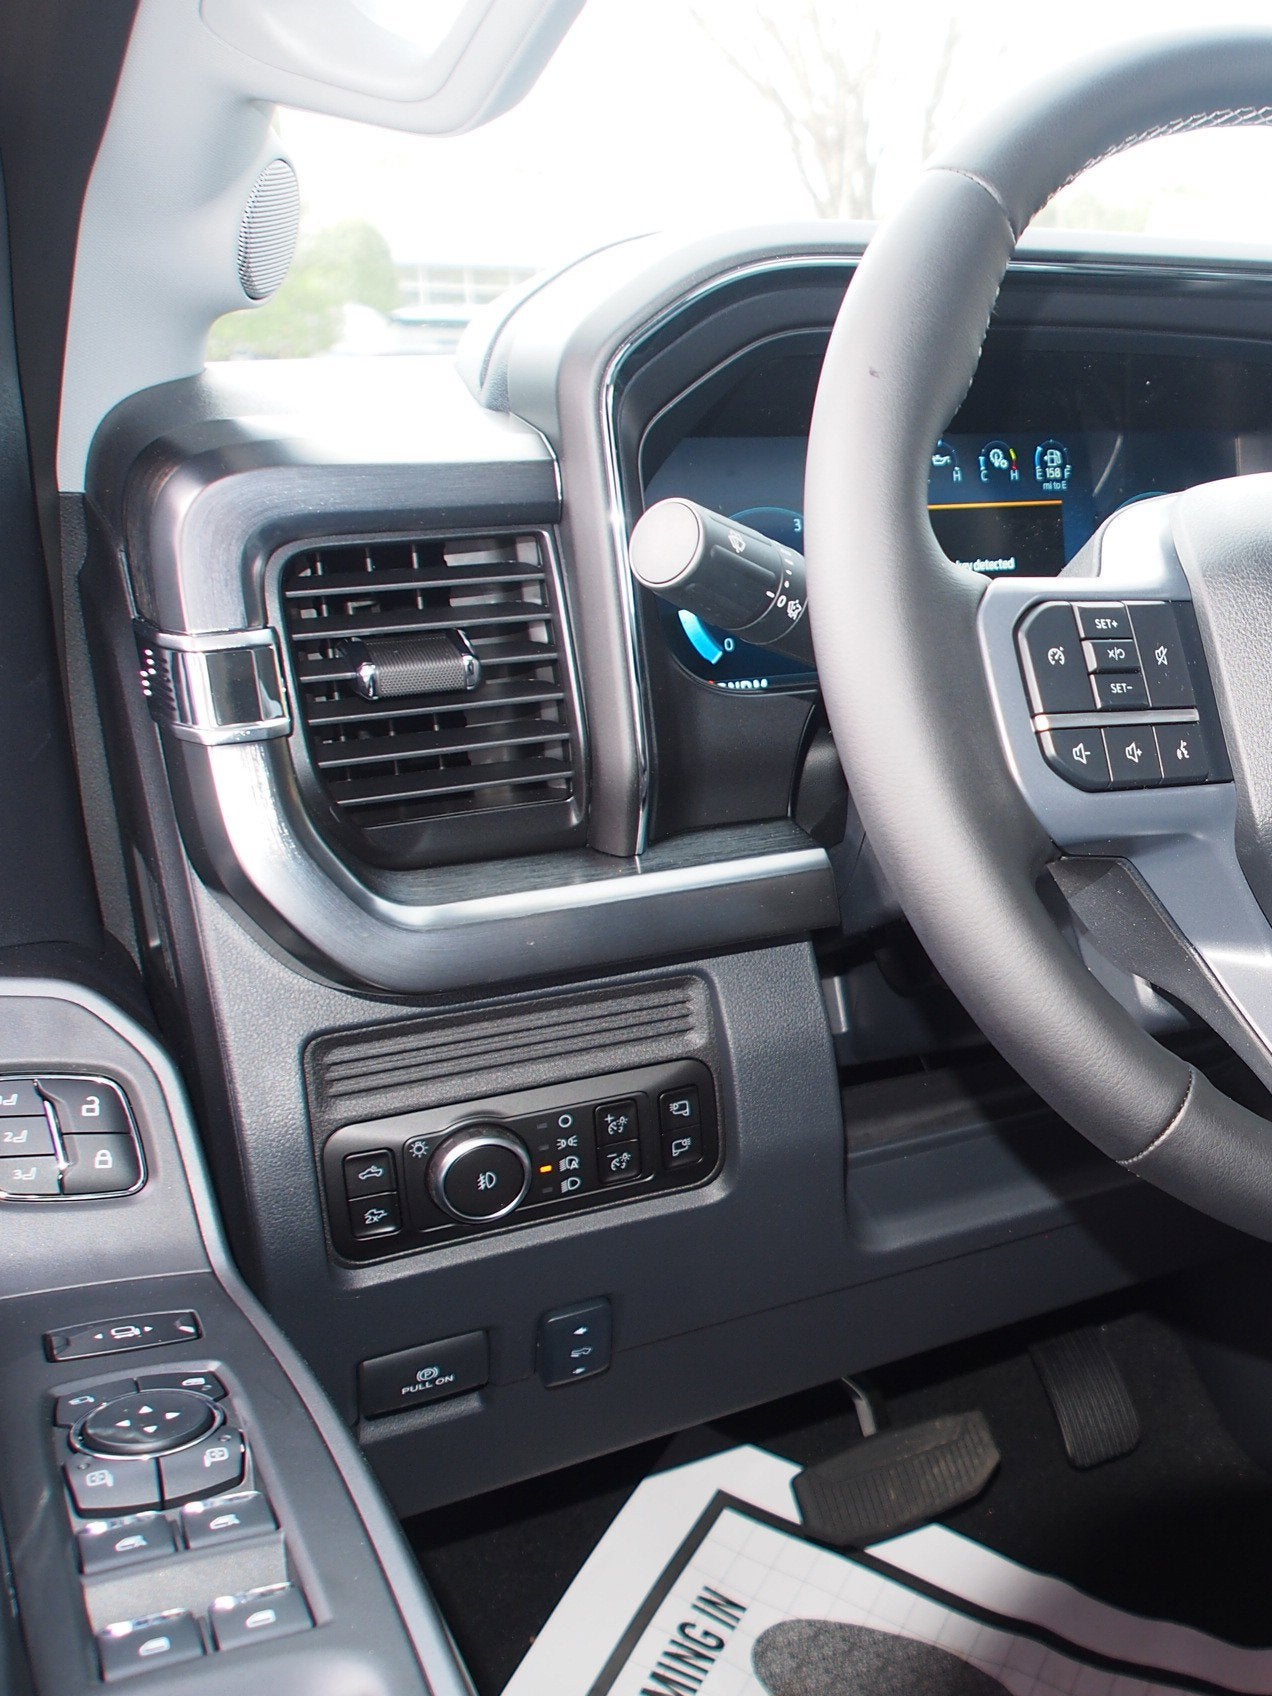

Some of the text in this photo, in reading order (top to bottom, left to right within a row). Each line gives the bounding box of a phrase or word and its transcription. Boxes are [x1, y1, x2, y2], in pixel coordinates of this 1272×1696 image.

[952, 470, 962, 482] H
[980, 469, 1020, 482] C H
[1035, 467, 1072, 480] E 158 F
[1042, 481, 1053, 490] mi
[1053, 481, 1062, 490] to
[973, 557, 1015, 573] detected
[1094, 618, 1119, 629] SET+
[724, 638, 735, 652] 0
[1110, 683, 1133, 694] SET-
[401, 1374, 455, 1395] PULL ON
[690, 1585, 747, 1632] IN
